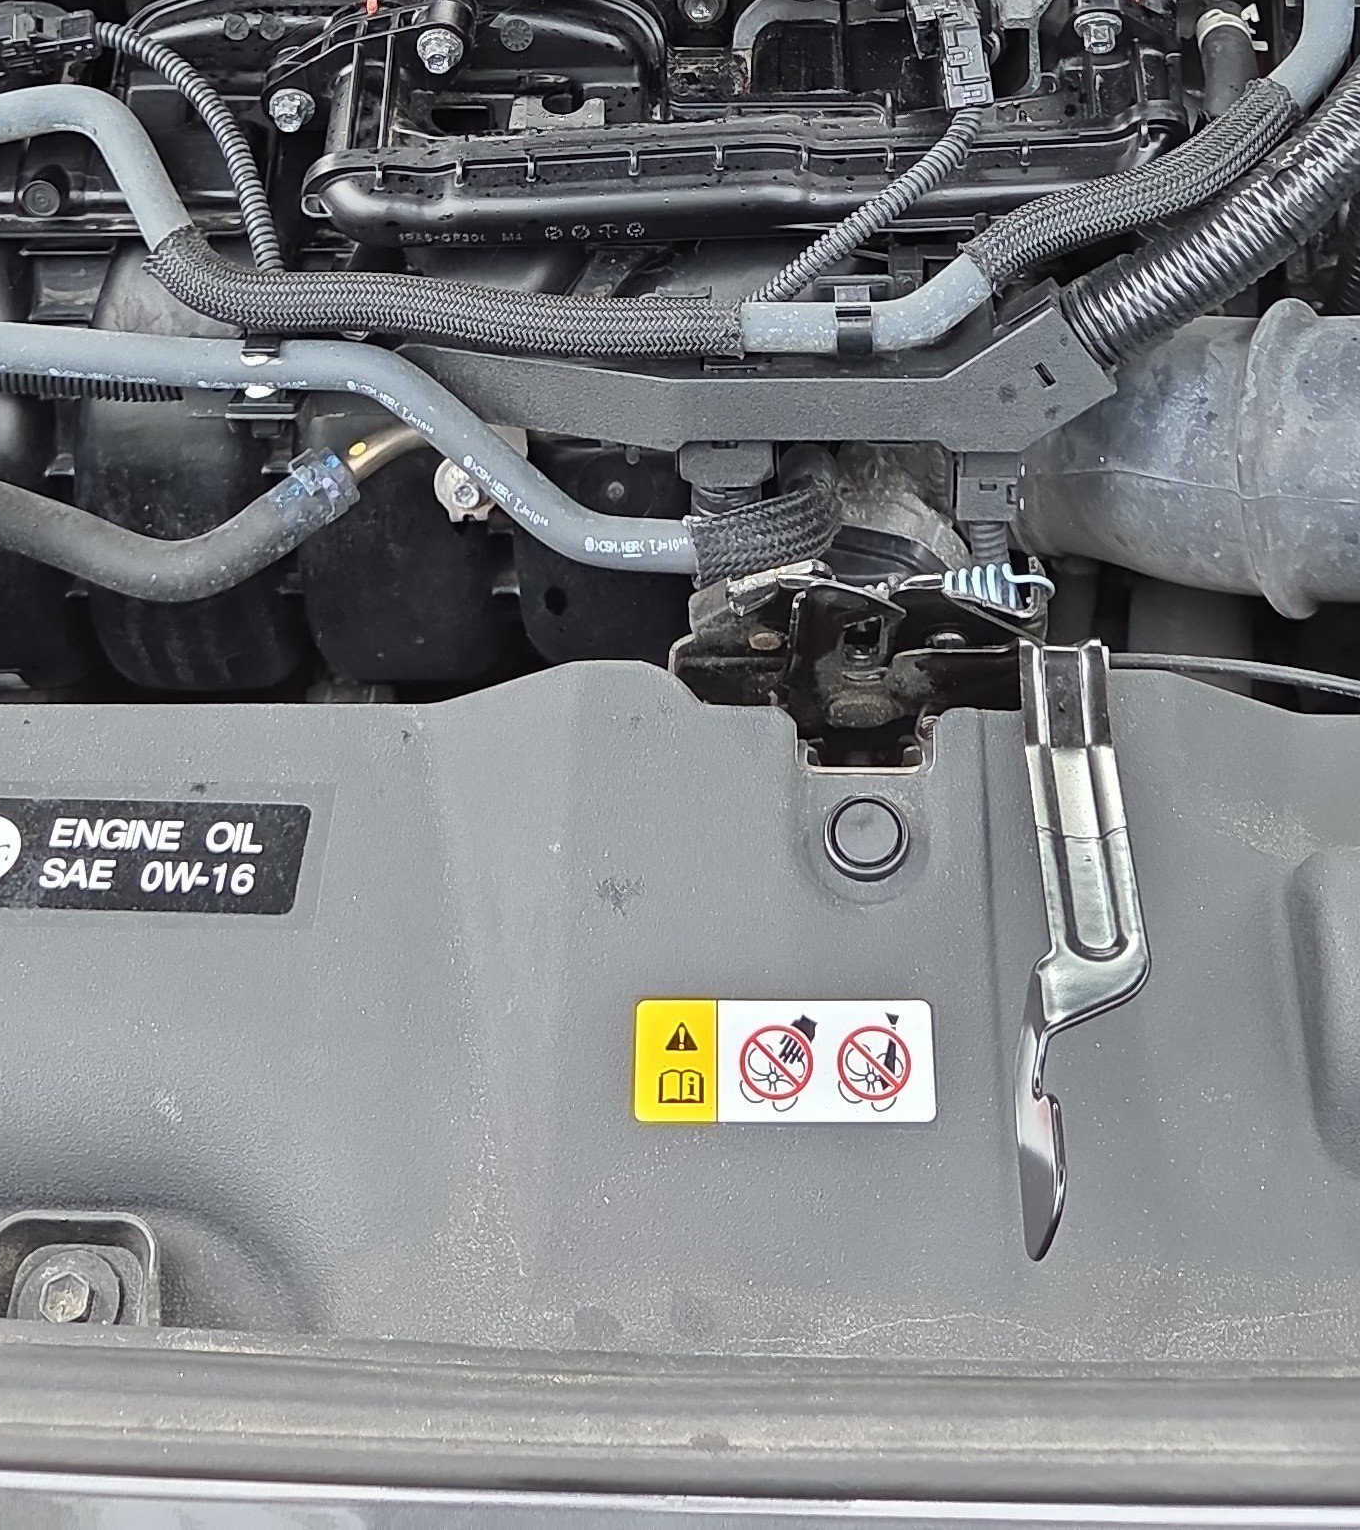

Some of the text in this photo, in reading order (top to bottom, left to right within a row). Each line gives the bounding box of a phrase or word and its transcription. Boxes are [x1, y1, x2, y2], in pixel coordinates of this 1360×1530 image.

[49, 817, 264, 855] ENGINE OIL
[39, 857, 257, 897] SAE 0W-16
